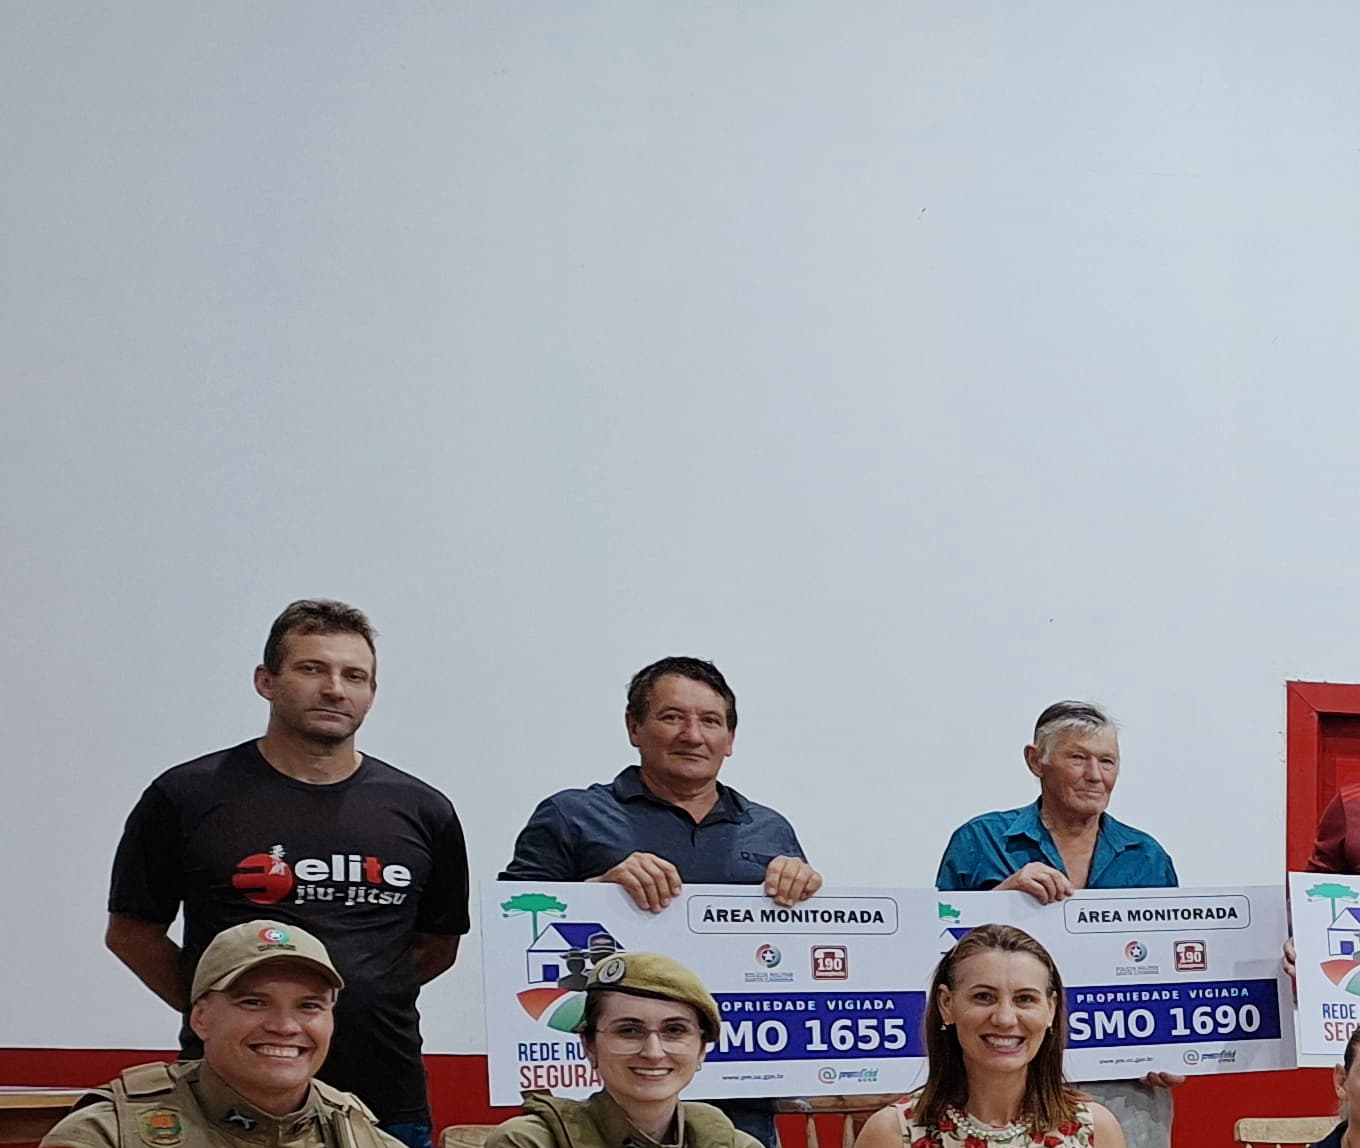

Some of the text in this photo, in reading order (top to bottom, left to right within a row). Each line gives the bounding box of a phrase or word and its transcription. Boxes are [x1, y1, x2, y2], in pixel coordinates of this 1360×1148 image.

[295, 855, 411, 887] elite
[295, 885, 406, 905] jiu-jitsu
[703, 905, 884, 923] ÁREA MONITORADA
[1078, 907, 1237, 923] ÁREA MONITORADA
[818, 958, 842, 971] 190
[1077, 988, 1248, 1003] PROPRIEDADE VIGIADA
[720, 1000, 894, 1011] OPRIEDADE VIGIADA
[1323, 1004, 1356, 1019] REDE
[1069, 1005, 1260, 1040] SMO 1690
[706, 1019, 906, 1053] MO 1655
[518, 1043, 560, 1061] REDE
[520, 1065, 601, 1088] SEGURA
